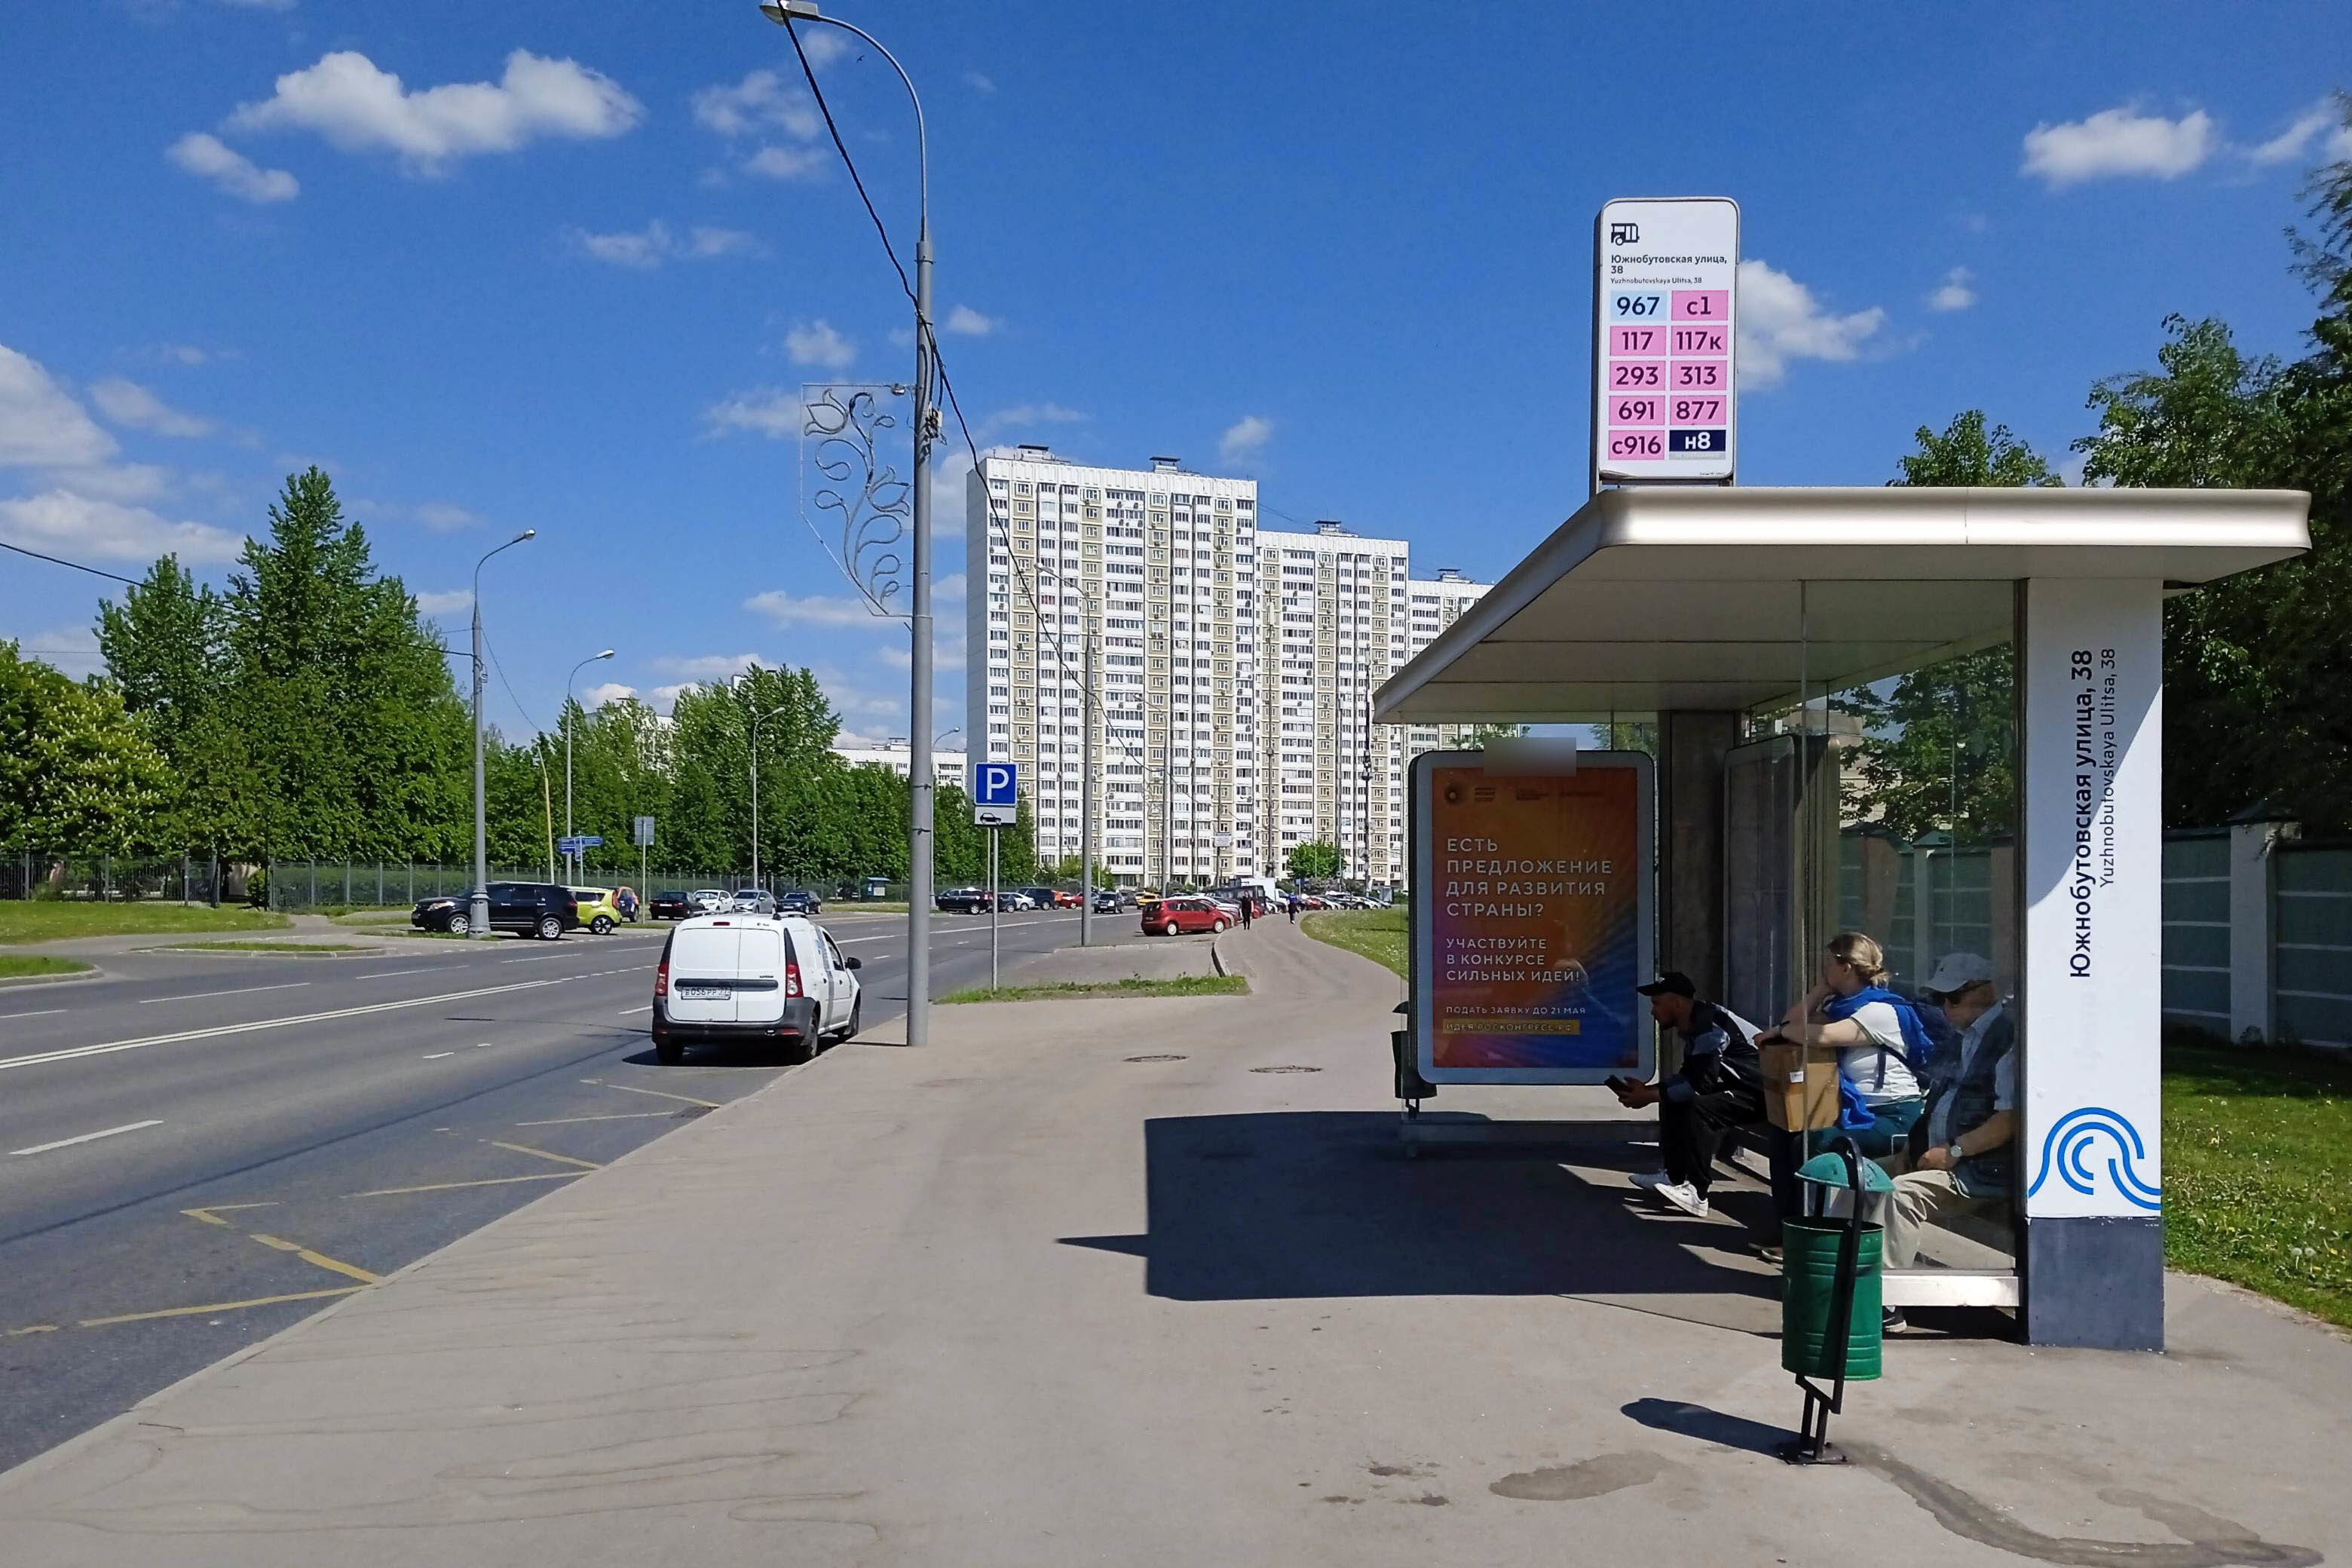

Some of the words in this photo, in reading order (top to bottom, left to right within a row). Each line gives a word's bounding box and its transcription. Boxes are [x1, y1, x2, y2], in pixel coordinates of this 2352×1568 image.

[1611, 255, 1692, 265] Южнобутовская
[1695, 256, 1727, 265] улица,
[1611, 265, 1624, 274] 38
[1616, 296, 1660, 315] 967
[1622, 332, 1653, 350] 117
[1615, 366, 1658, 385] 293
[1680, 366, 1717, 385] 313
[1619, 401, 1655, 420] 691
[1676, 401, 1720, 420] 877
[2072, 650, 2093, 681] 38
[2100, 648, 2115, 669] 38
[2100, 674, 2117, 726] Ulitsa,
[2076, 688, 2096, 767] улица,
[2099, 730, 2118, 887] Yuzhnobutovskaya
[1447, 838, 1498, 852] ЕСТЬ
[1447, 859, 1612, 875] ПРЕДЛОЖЕНИЕ
[2070, 774, 2096, 978] Южнобутовская
[1446, 881, 1488, 897] ДЛЯ
[1497, 881, 1605, 896] РАЗВИТИЯ
[1447, 902, 1544, 917] СТРАНЫ?
[1446, 936, 1547, 949] УЧАСТВУЙТЕ
[1447, 954, 1455, 965] В
[1461, 954, 1545, 966] КОНКУРСЕ
[1447, 970, 1525, 982] СИЛЬНЫХ
[1531, 969, 1580, 982] ИДЕЙ!
[1446, 1006, 1487, 1015] ПОДАТЬ
[1532, 1007, 1548, 1015] ДО
